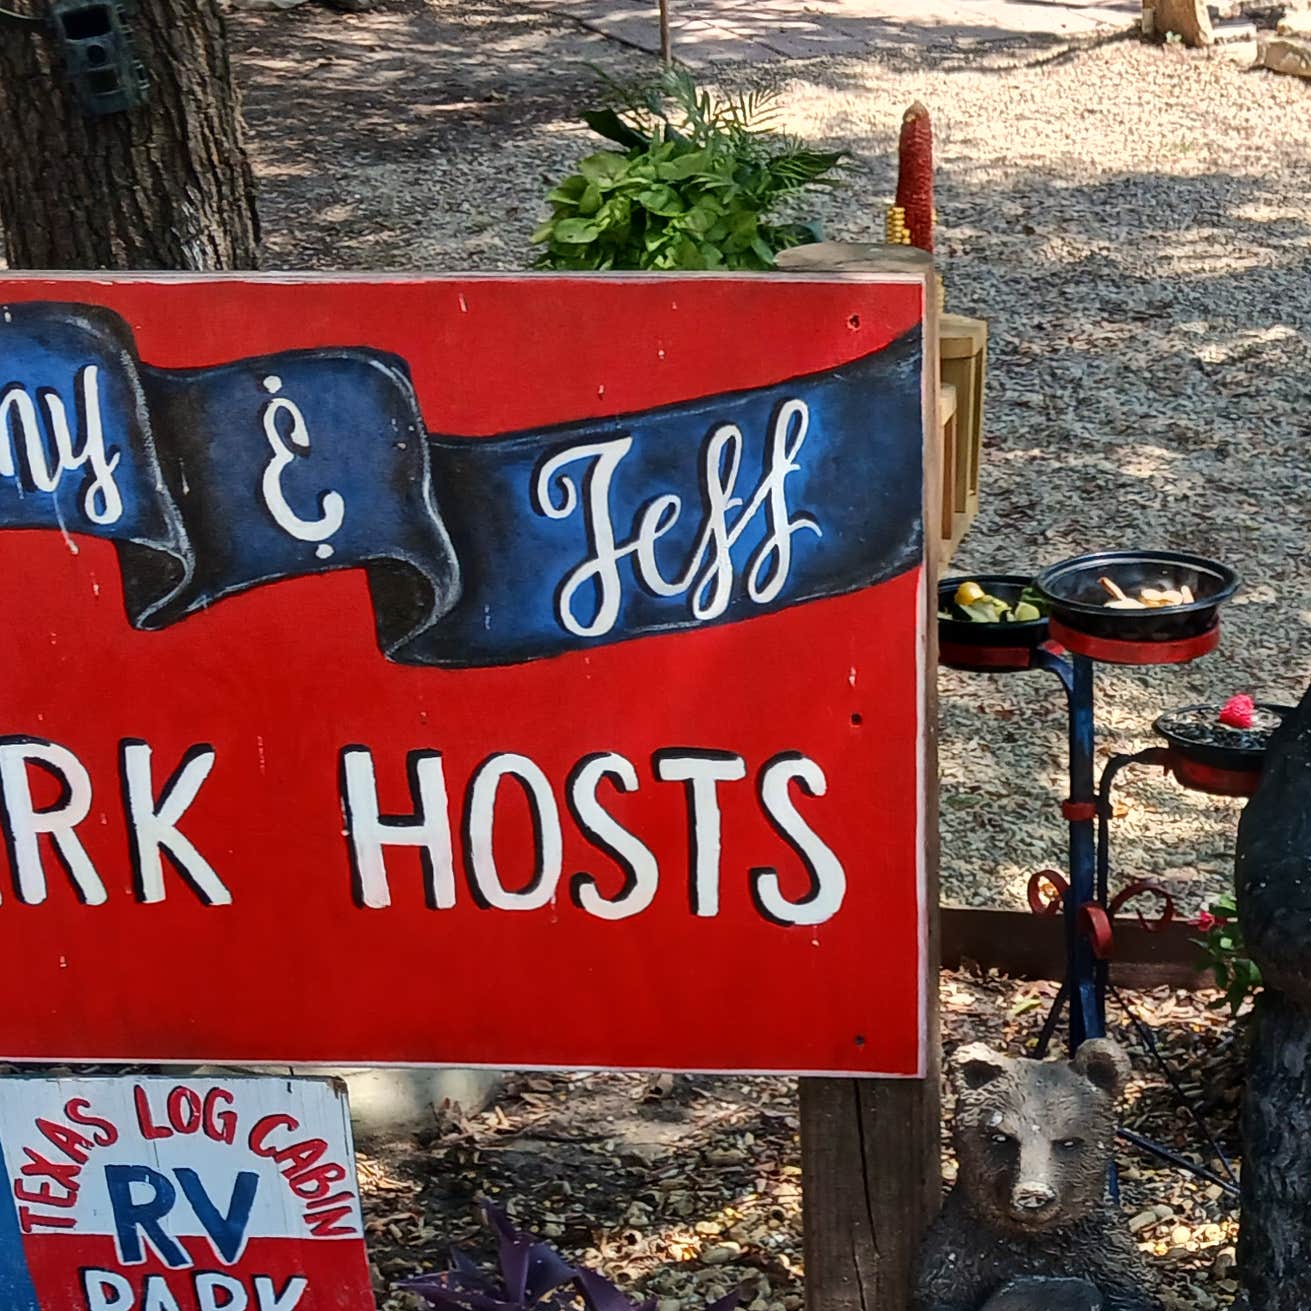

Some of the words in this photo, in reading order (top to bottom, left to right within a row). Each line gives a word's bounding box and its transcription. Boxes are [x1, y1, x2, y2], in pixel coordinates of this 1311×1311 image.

[0, 738, 233, 905] RK
[342, 747, 847, 926] HOSTS
[14, 1098, 119, 1233] TEXAS
[133, 1084, 238, 1145] LOG
[248, 1113, 358, 1236] CABIN
[104, 1164, 259, 1267] RV
